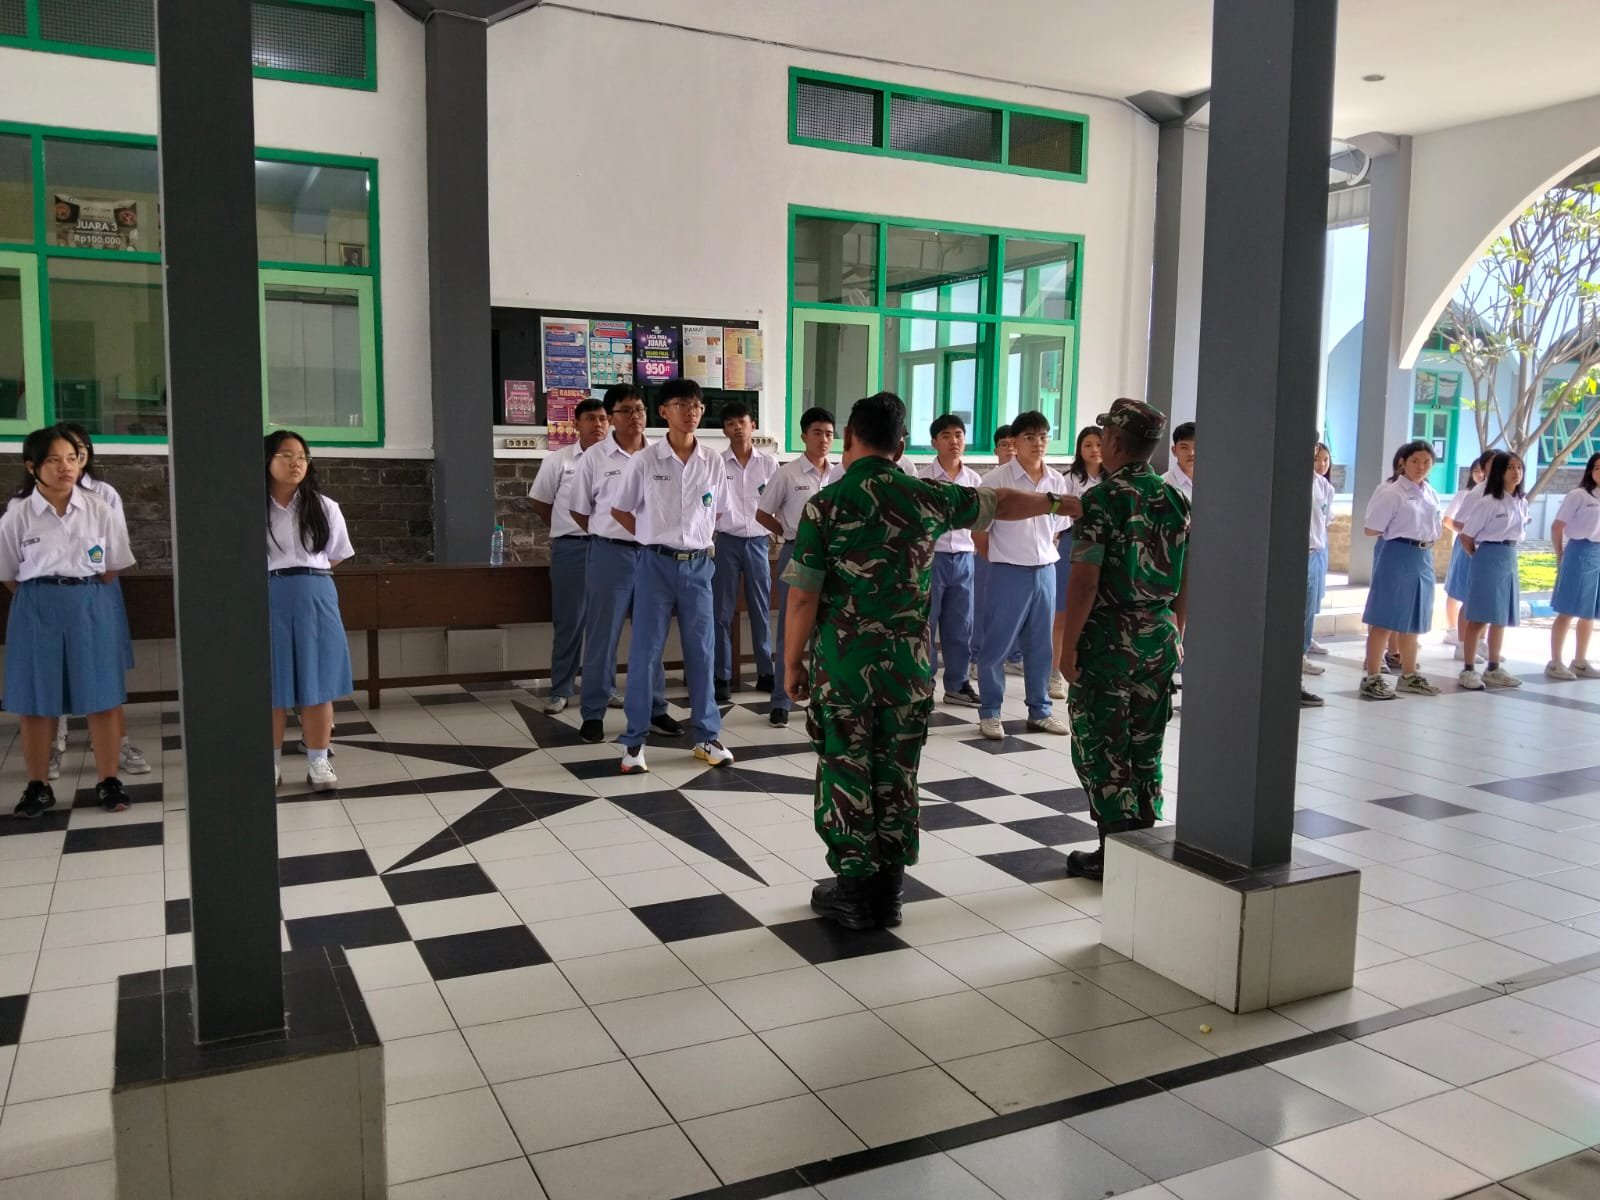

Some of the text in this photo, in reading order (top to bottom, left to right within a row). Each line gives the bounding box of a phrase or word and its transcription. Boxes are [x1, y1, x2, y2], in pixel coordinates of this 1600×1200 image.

[76, 220, 118, 231] JUARA 3
[74, 234, 121, 245] Rp100.000
[647, 339, 668, 347] JUARA
[645, 362, 665, 375] 950
